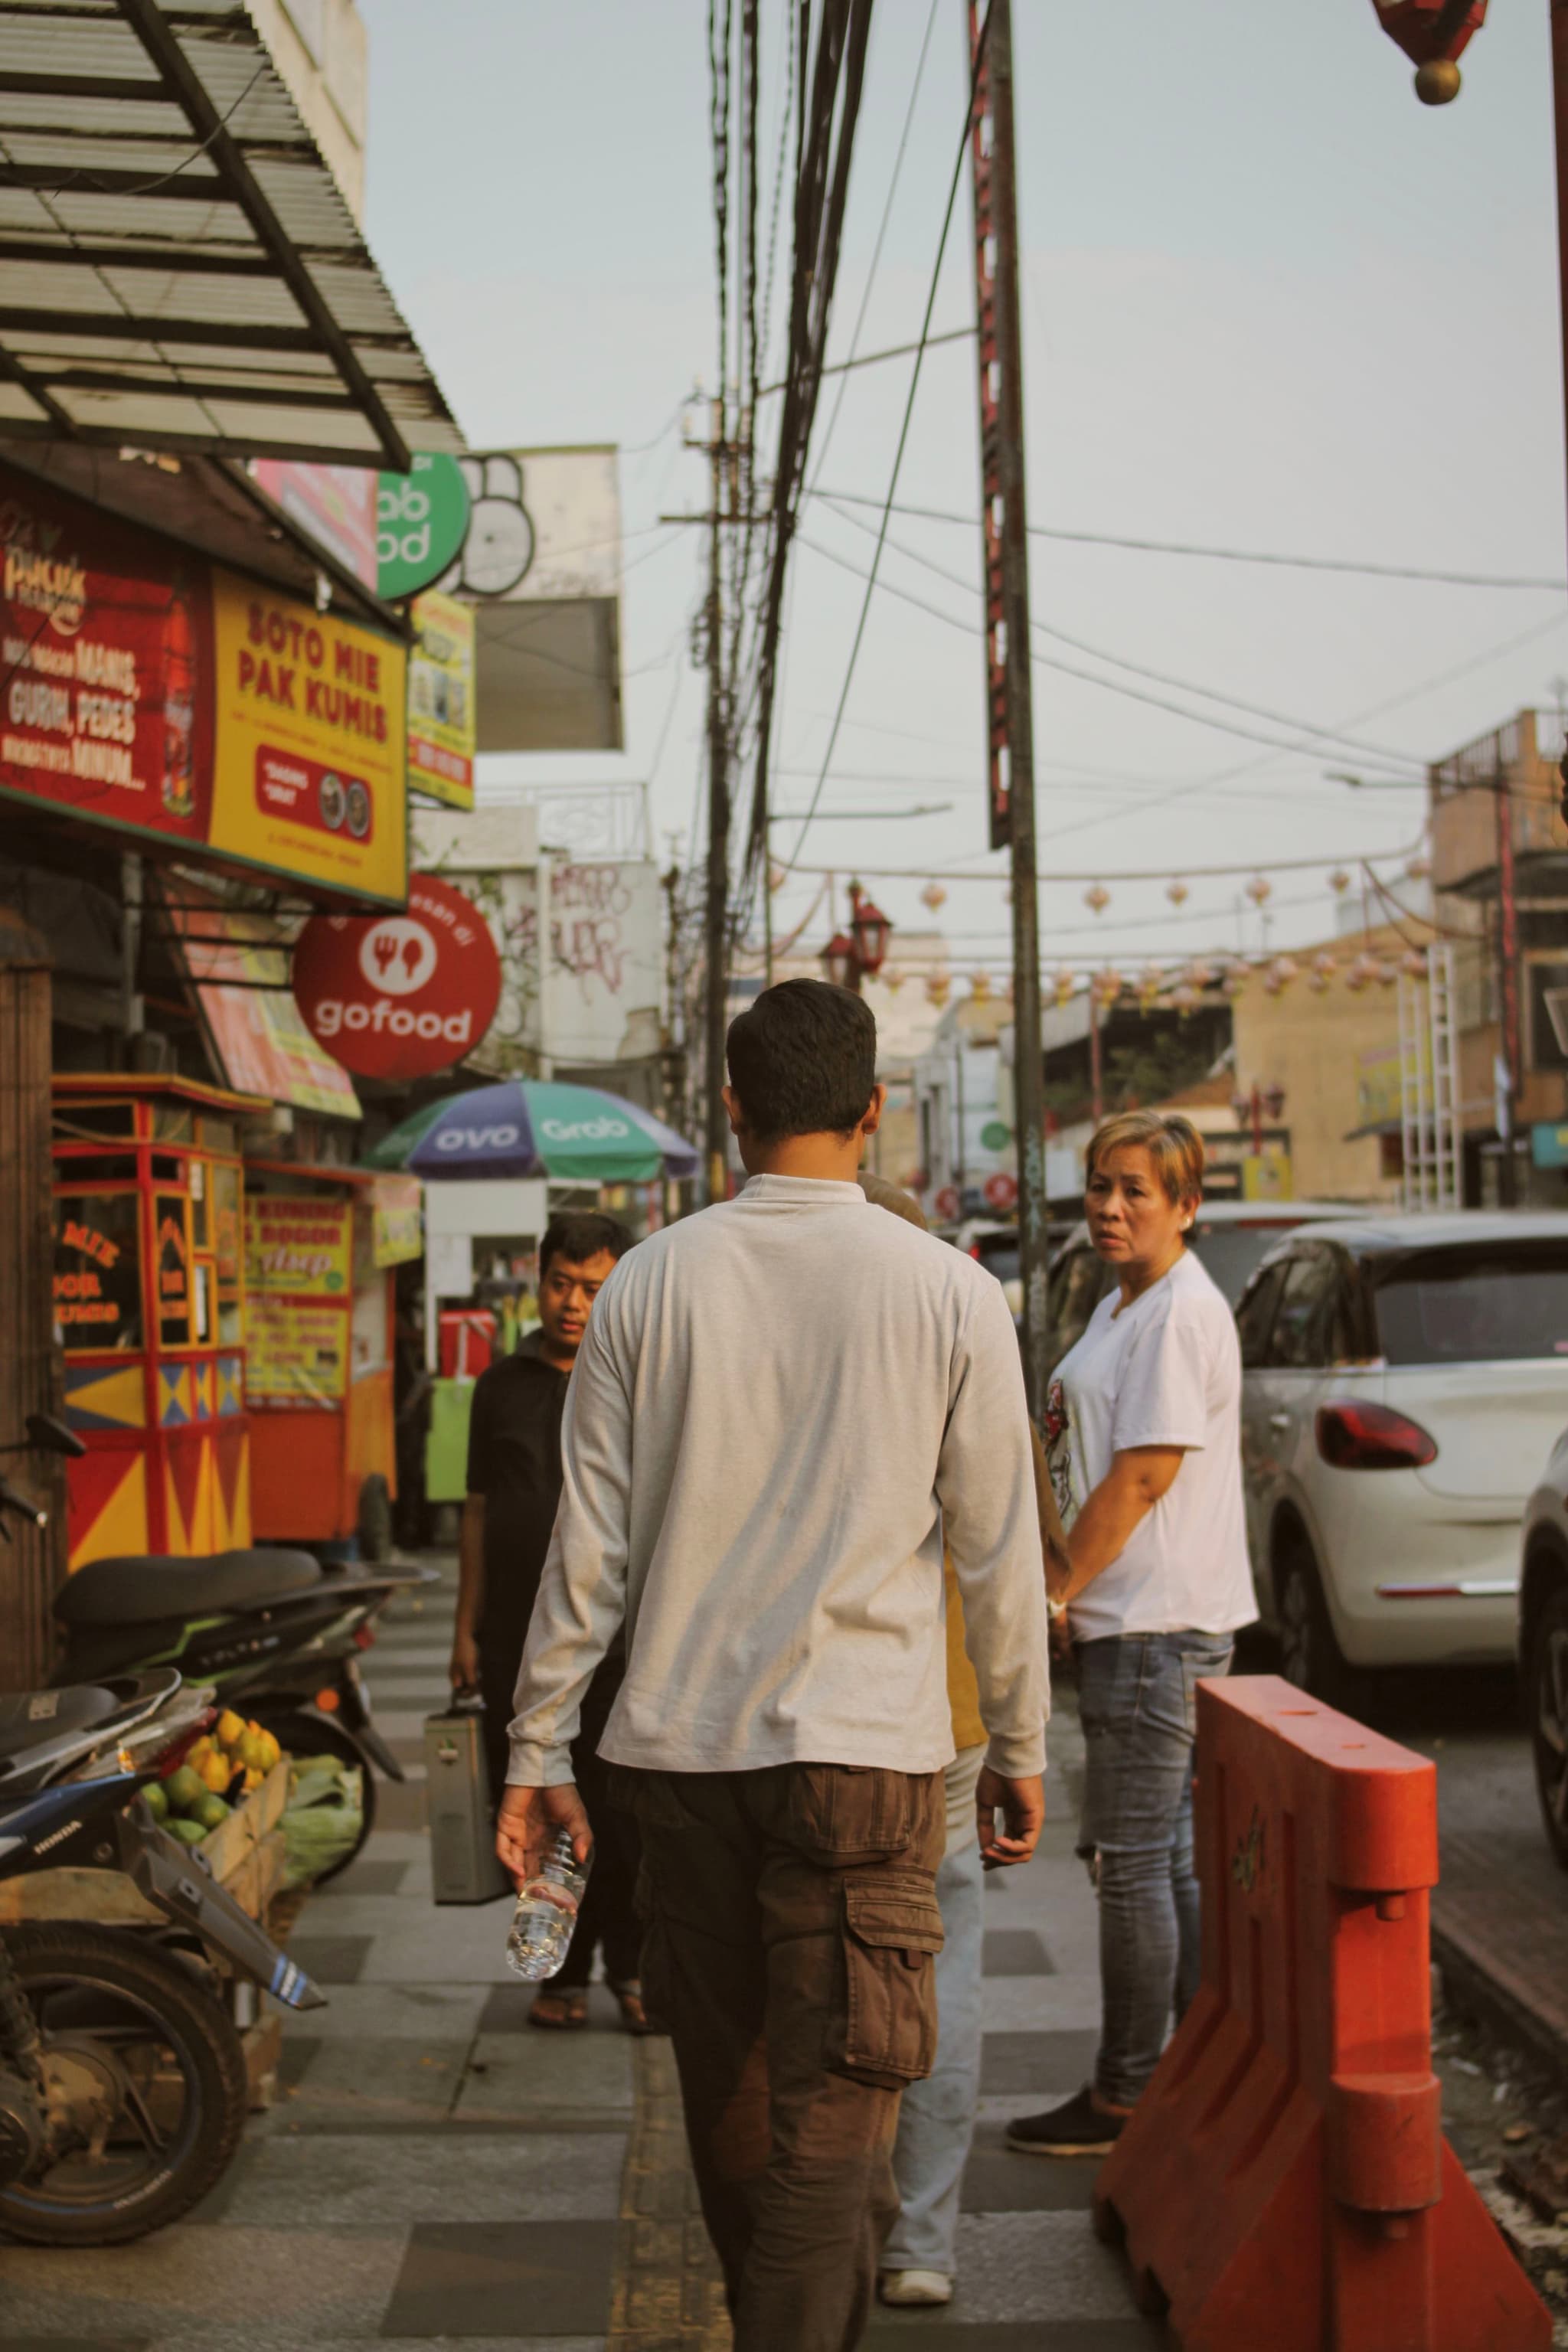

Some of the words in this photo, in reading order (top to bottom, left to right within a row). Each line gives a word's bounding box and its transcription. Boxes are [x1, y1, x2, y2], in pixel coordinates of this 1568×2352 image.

[377, 480, 431, 523] ab
[377, 523, 432, 564] od
[247, 600, 325, 671] SOTO
[334, 639, 380, 694] MIE
[77, 691, 136, 745] PEDES
[237, 649, 296, 711] PAK
[305, 676, 388, 744] KUMIS
[410, 893, 456, 927] esan
[453, 926, 476, 947] di
[315, 998, 473, 1044] gofood
[540, 1116, 630, 1140] Grab
[62, 1220, 121, 1269] MIE
[55, 1303, 120, 1325] UMIS
[34, 1820, 83, 1855] HONDA
